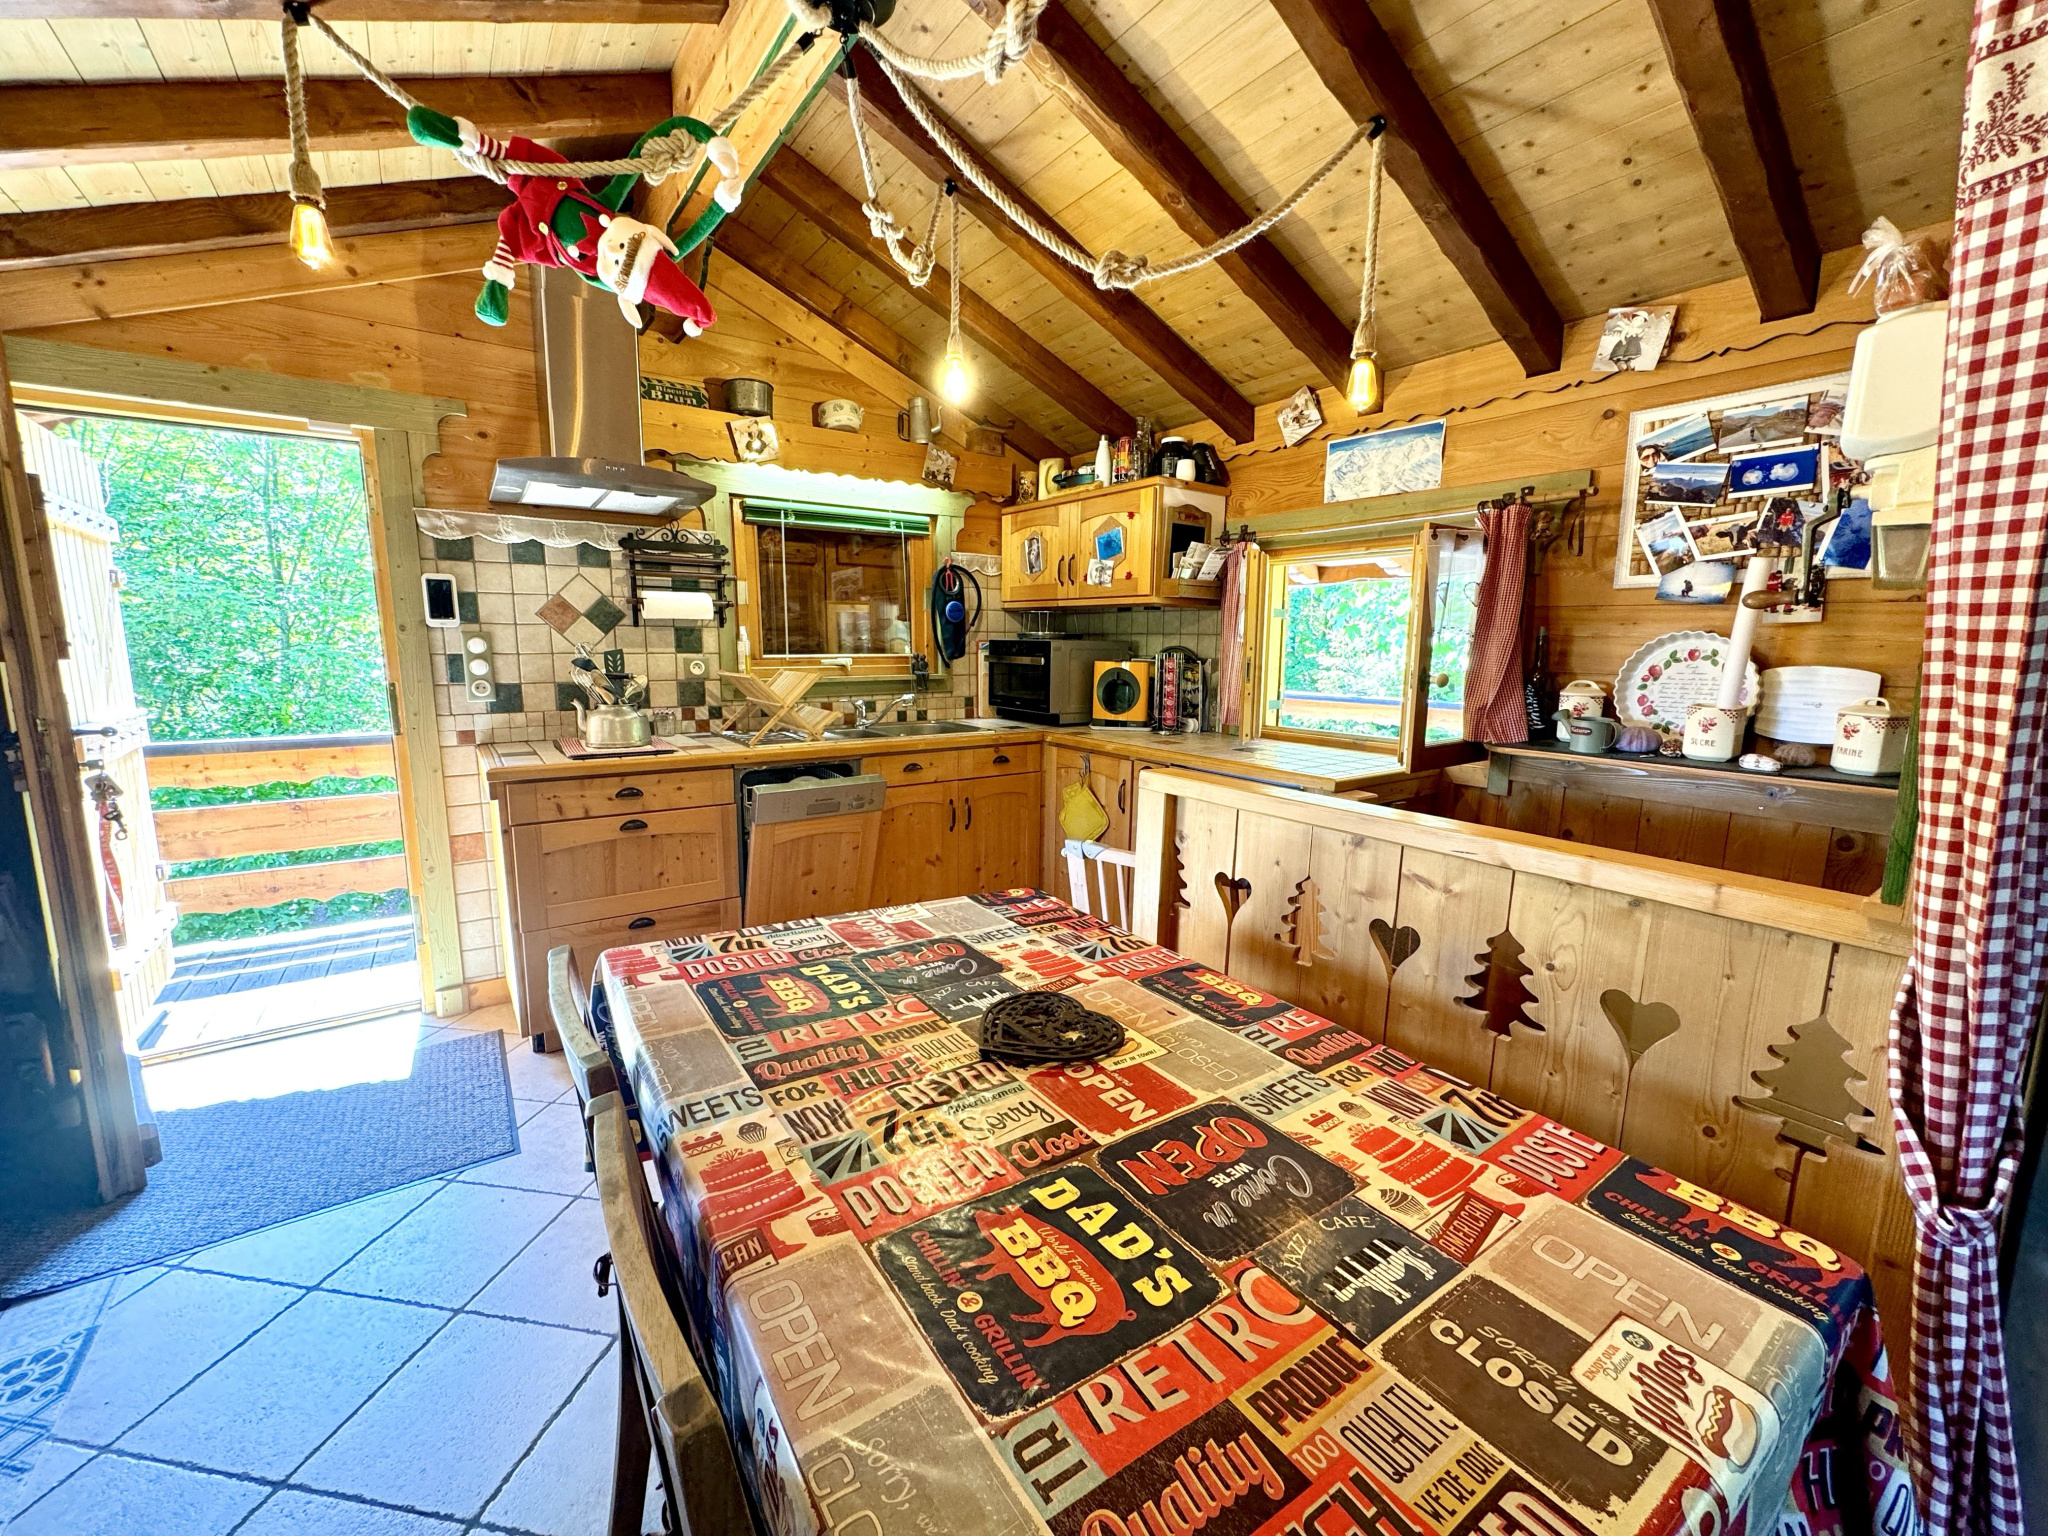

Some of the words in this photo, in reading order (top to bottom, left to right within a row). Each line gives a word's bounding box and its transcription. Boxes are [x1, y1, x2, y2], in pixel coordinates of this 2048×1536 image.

[651, 390, 697, 405] Brun
[656, 385, 693, 397] Biscuits
[1836, 745, 1864, 758] FARINE
[766, 927, 824, 939] Advertisement
[856, 917, 905, 947] OPEN
[964, 926, 1031, 944] SWEETS
[1016, 908, 1078, 925] Quality
[1034, 925, 1062, 935] FOR
[665, 935, 705, 947] NOW
[713, 936, 767, 953] 7th
[772, 934, 836, 950] Sorry
[862, 943, 966, 972] OPEN
[1047, 931, 1089, 948] NOW
[1100, 937, 1152, 952] 7th
[685, 951, 790, 979] POSTER
[922, 958, 977, 978] Come
[767, 978, 814, 1014] BBQ
[800, 965, 872, 1009] DAD'S
[1195, 973, 1263, 1006] BBQ
[1084, 991, 1158, 1031] OPEN
[755, 1044, 870, 1080] Quality
[881, 1046, 906, 1058] 100
[1154, 1035, 1238, 1082] CLOSED
[1285, 1031, 1372, 1065] Quality
[768, 1082, 825, 1107] FOR
[896, 1063, 1011, 1108] NEVER
[1063, 1065, 1158, 1123] OPEN
[1240, 1070, 1331, 1116] SWEETS
[1326, 1065, 1374, 1087] FOR
[657, 1087, 764, 1152] SWEETS
[960, 1099, 1055, 1139] Sorry
[1361, 1078, 1441, 1120] NOW
[784, 1099, 852, 1144] NOW
[866, 1109, 954, 1155] 7th
[1117, 1116, 1268, 1196] OPEN
[1208, 1162, 1254, 1188] WE'RE
[842, 1145, 1006, 1228] POSTER
[1231, 1155, 1314, 1207] Come
[1204, 1200, 1238, 1228] in
[1425, 1220, 1446, 1239] BUY
[1439, 1197, 1494, 1257] AMERICAN
[1604, 1190, 1712, 1242] CHILLIN'
[1666, 1178, 1842, 1272] BBQ
[911, 1230, 971, 1289] CHILLIN'
[1029, 1177, 1193, 1307] DAD'S
[1037, 1227, 1071, 1257] World
[1070, 1254, 1104, 1292] Famous
[1283, 1232, 1312, 1273] JAZZ
[1319, 1215, 1375, 1232] CAFE
[990, 1217, 1097, 1329] BBQ
[1620, 1212, 1667, 1236] Stand
[1712, 1258, 1760, 1284] Dad's
[1763, 1283, 1830, 1322] cooking
[1531, 1234, 1725, 1352] OPEN
[901, 1255, 927, 1283] Stand
[940, 1309, 965, 1341] Dad's
[962, 1342, 999, 1385] cooking
[749, 1279, 856, 1421] OPEN
[974, 1313, 1050, 1391] GRILLIN'
[1582, 1356, 1603, 1382] ENJOY
[1602, 1345, 1620, 1360] OUR
[1603, 1351, 1634, 1381] Delicious
[1429, 1319, 1634, 1466] CLOSED
[1588, 1402, 1652, 1445] we're
[1291, 1434, 1340, 1477] 100
[1080, 1431, 1285, 1536] Quality
[1412, 1469, 1477, 1527] WE'RE
